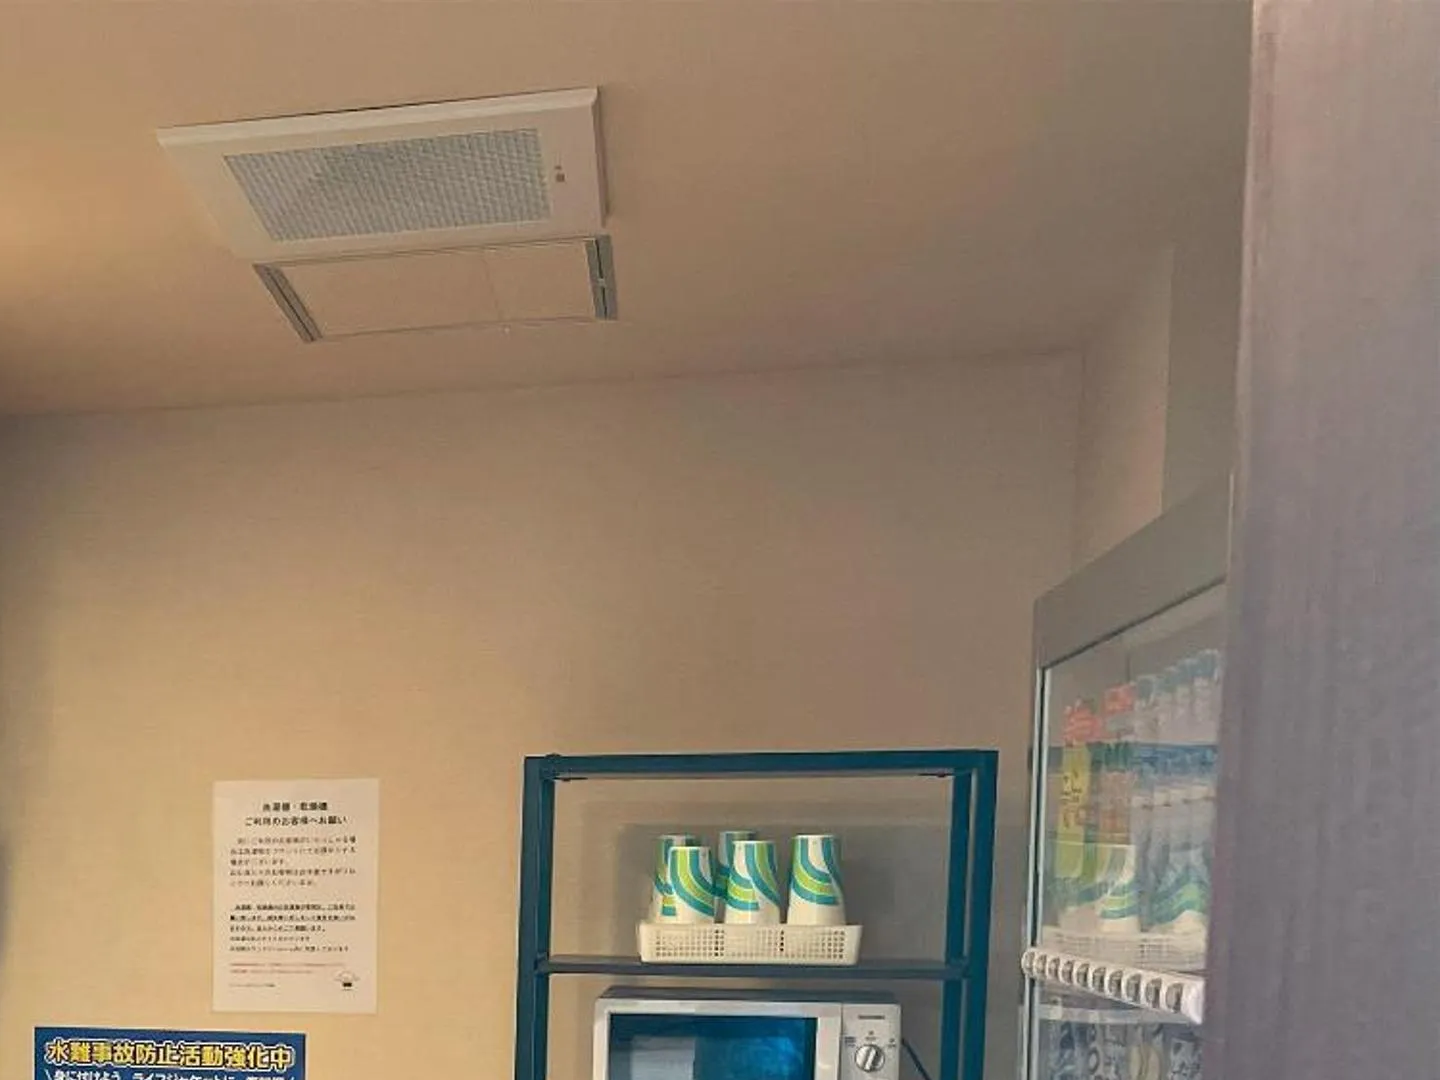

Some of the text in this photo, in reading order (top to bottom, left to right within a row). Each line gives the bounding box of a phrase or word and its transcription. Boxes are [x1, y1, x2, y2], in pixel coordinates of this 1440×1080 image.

[46, 1040, 295, 1073] 水難事故防止活動強化中
